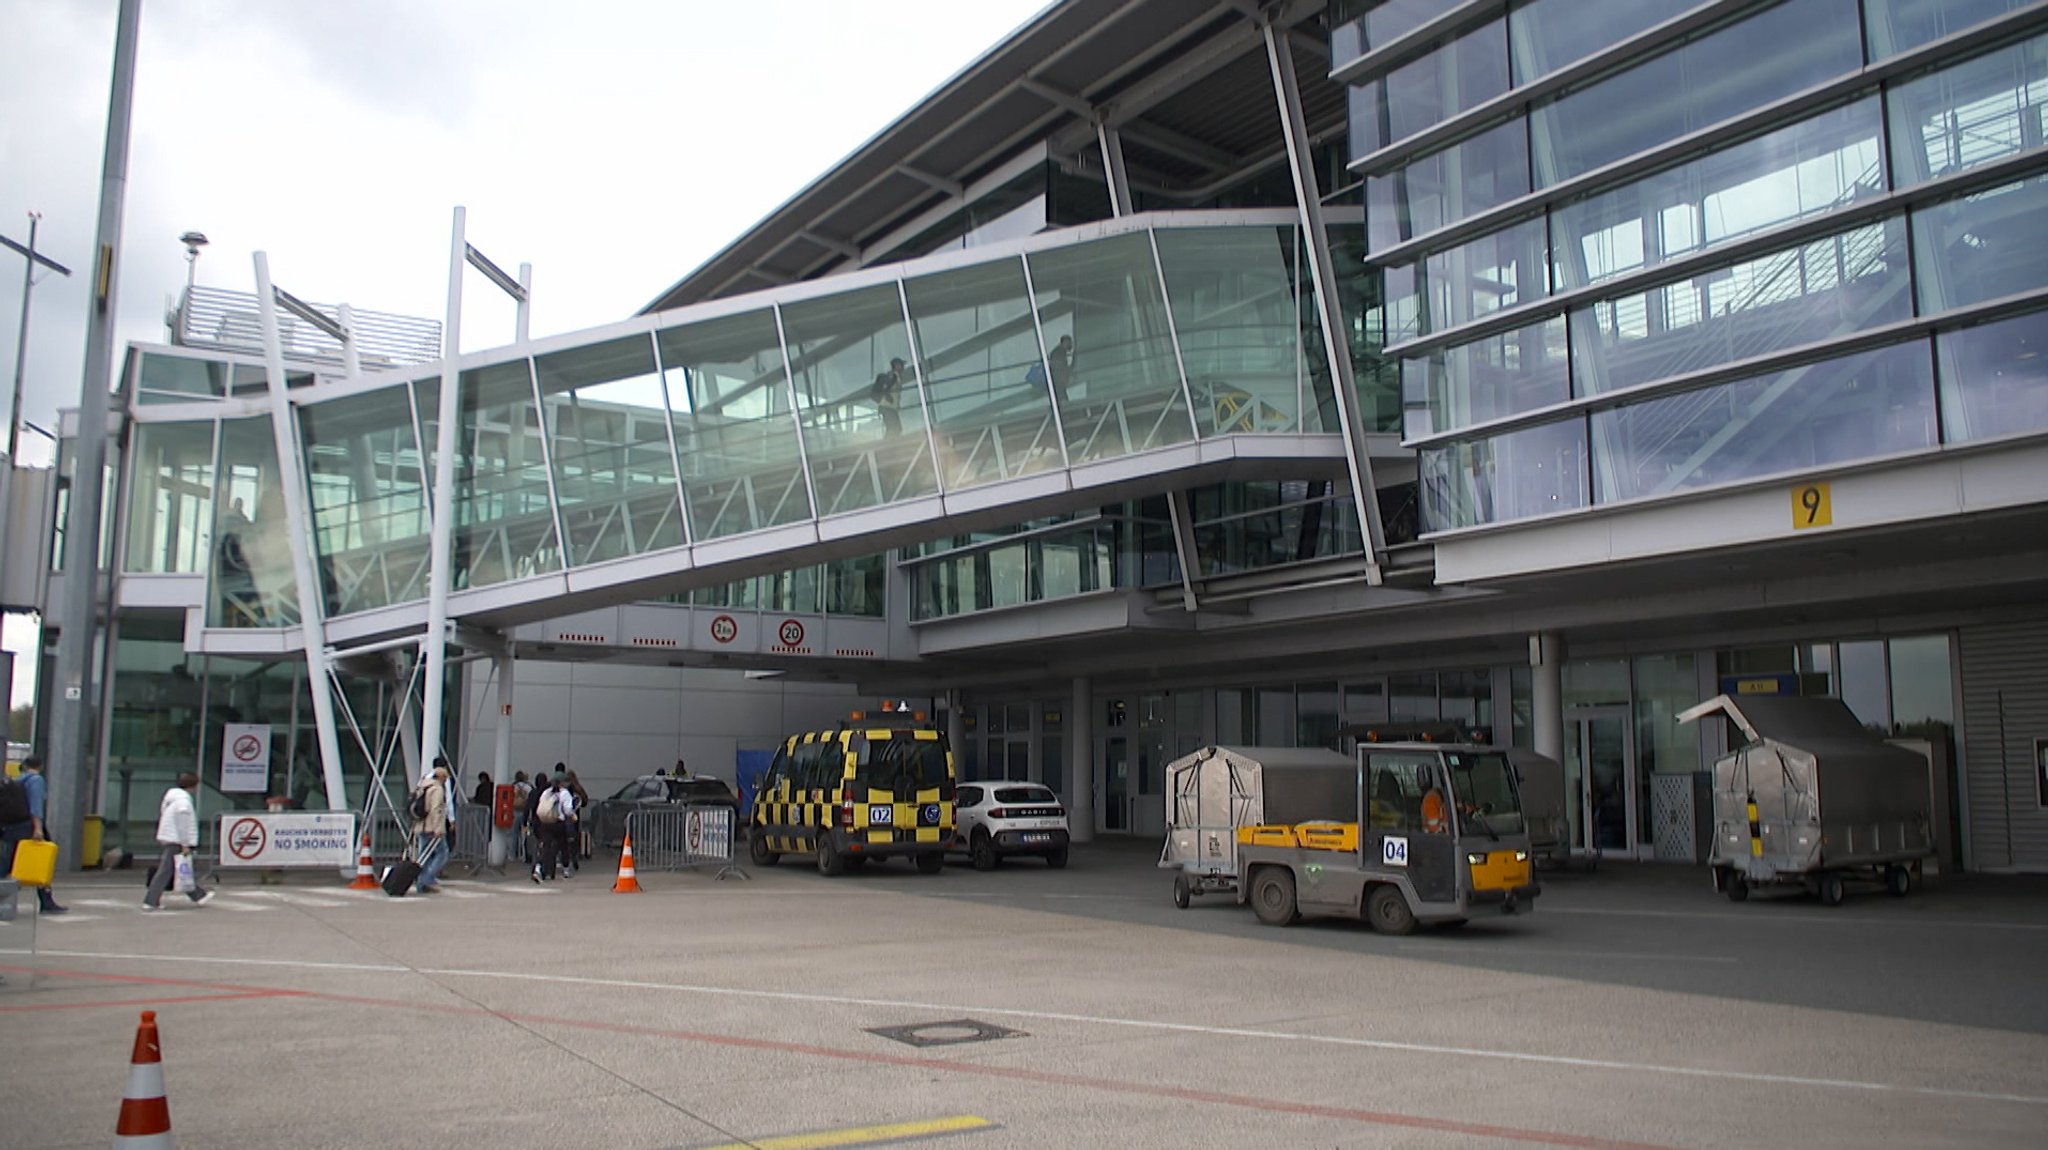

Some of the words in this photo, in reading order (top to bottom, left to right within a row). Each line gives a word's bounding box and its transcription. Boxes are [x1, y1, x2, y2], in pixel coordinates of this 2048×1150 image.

[1802, 487, 1820, 524] 9
[785, 625, 800, 640] 20
[872, 808, 890, 822] 02
[275, 839, 292, 849] NO
[294, 838, 347, 849] SMOKING
[1385, 840, 1405, 861] 04
